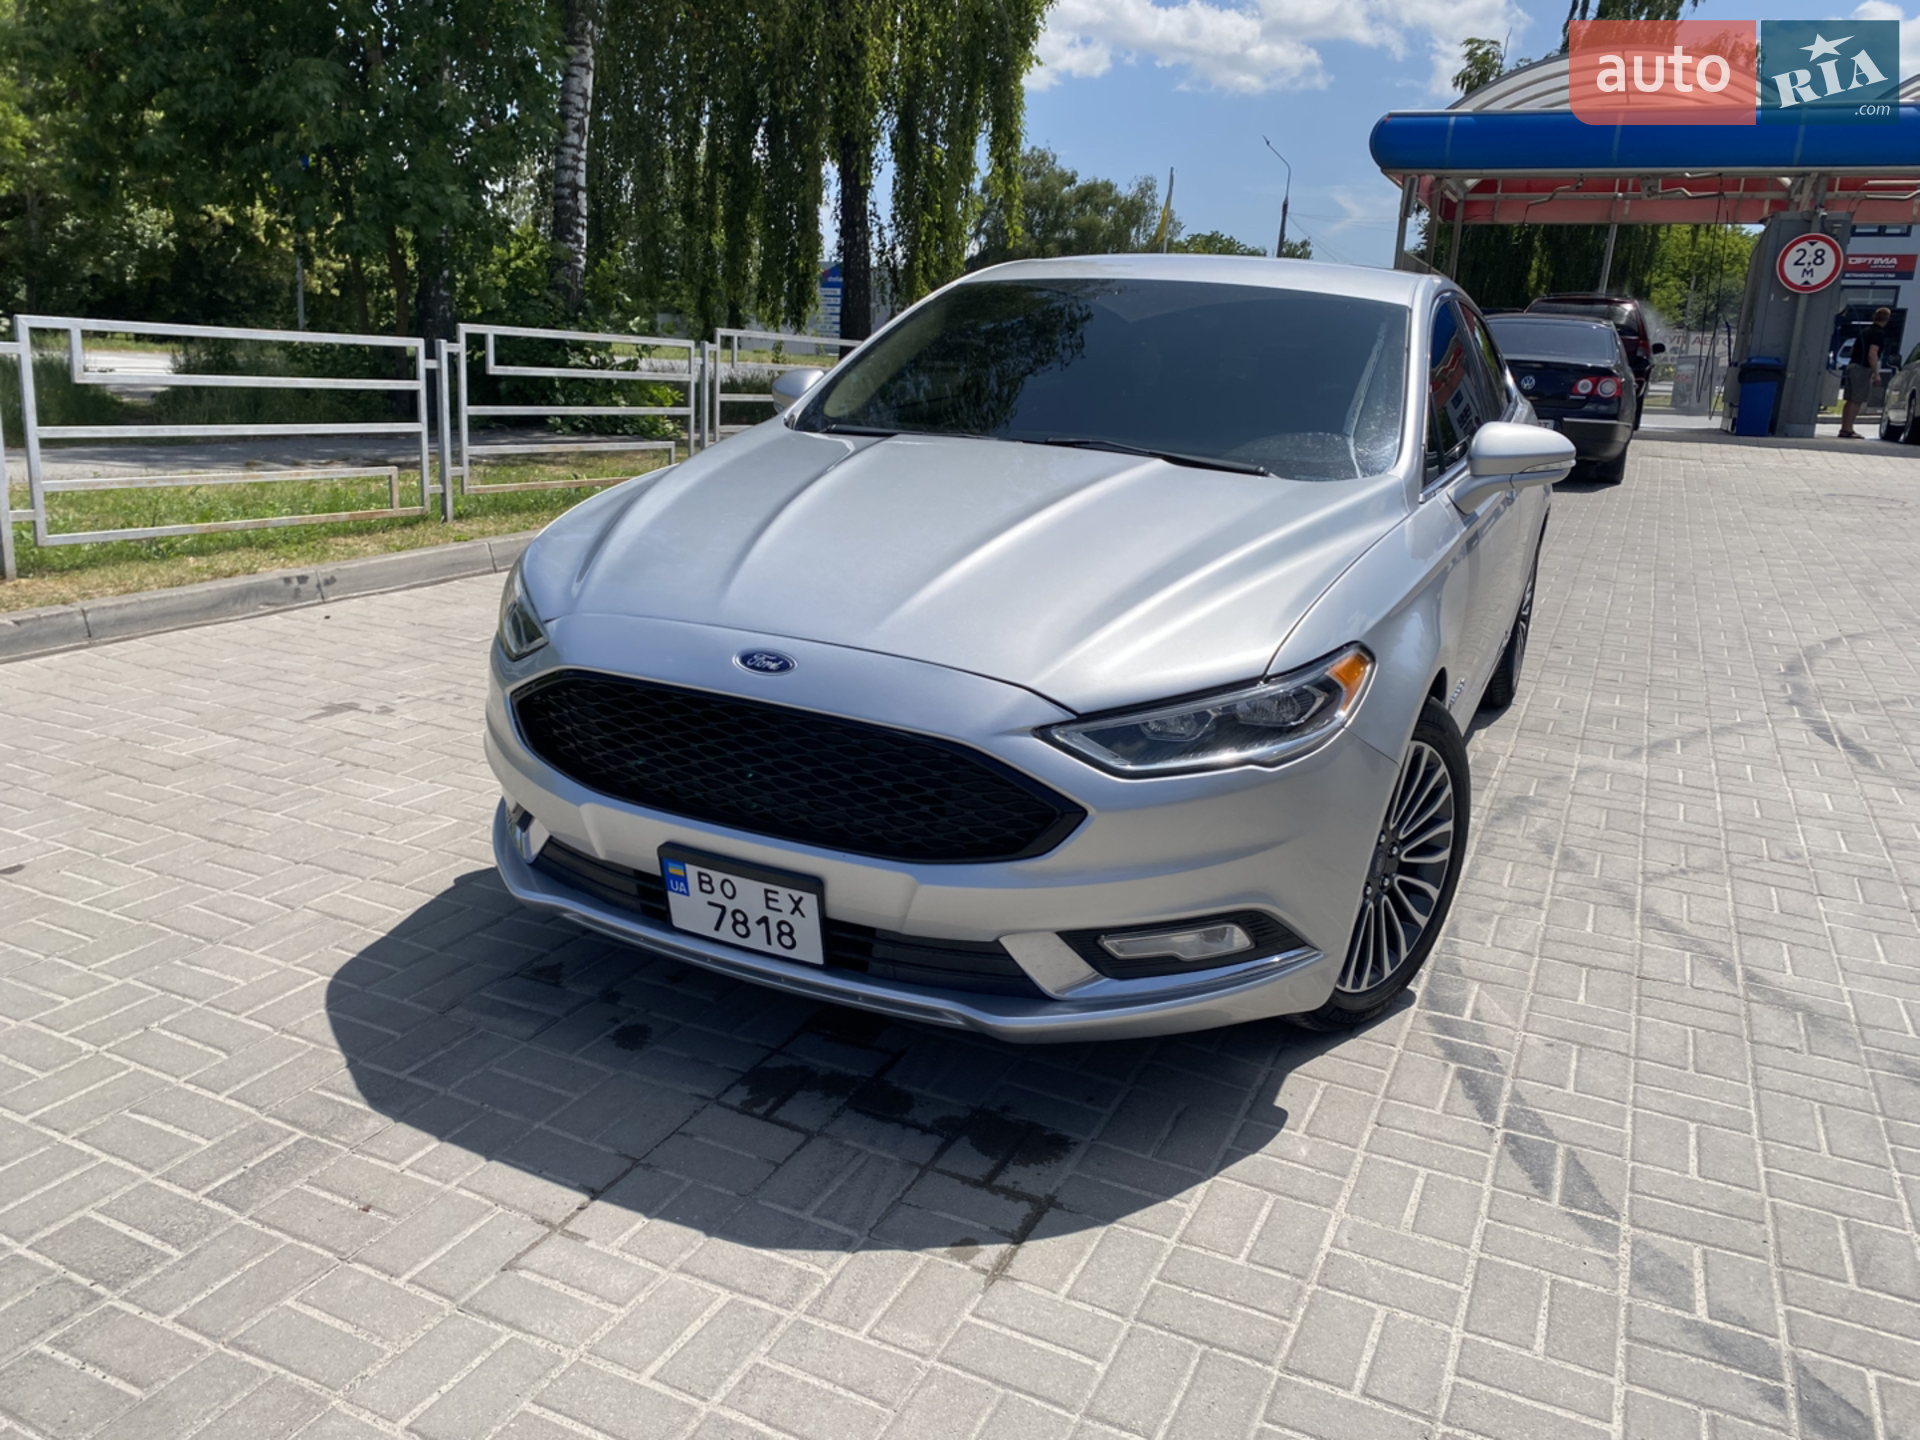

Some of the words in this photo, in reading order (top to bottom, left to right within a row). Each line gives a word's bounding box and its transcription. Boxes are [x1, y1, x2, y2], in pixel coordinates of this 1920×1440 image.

[1793, 248, 1826, 268] 2,8
[1848, 257, 1898, 265] OPTIMA
[747, 653, 783, 670] Ford
[670, 879, 688, 894] UA
[764, 888, 806, 918] EX
[707, 901, 797, 950] 7818
